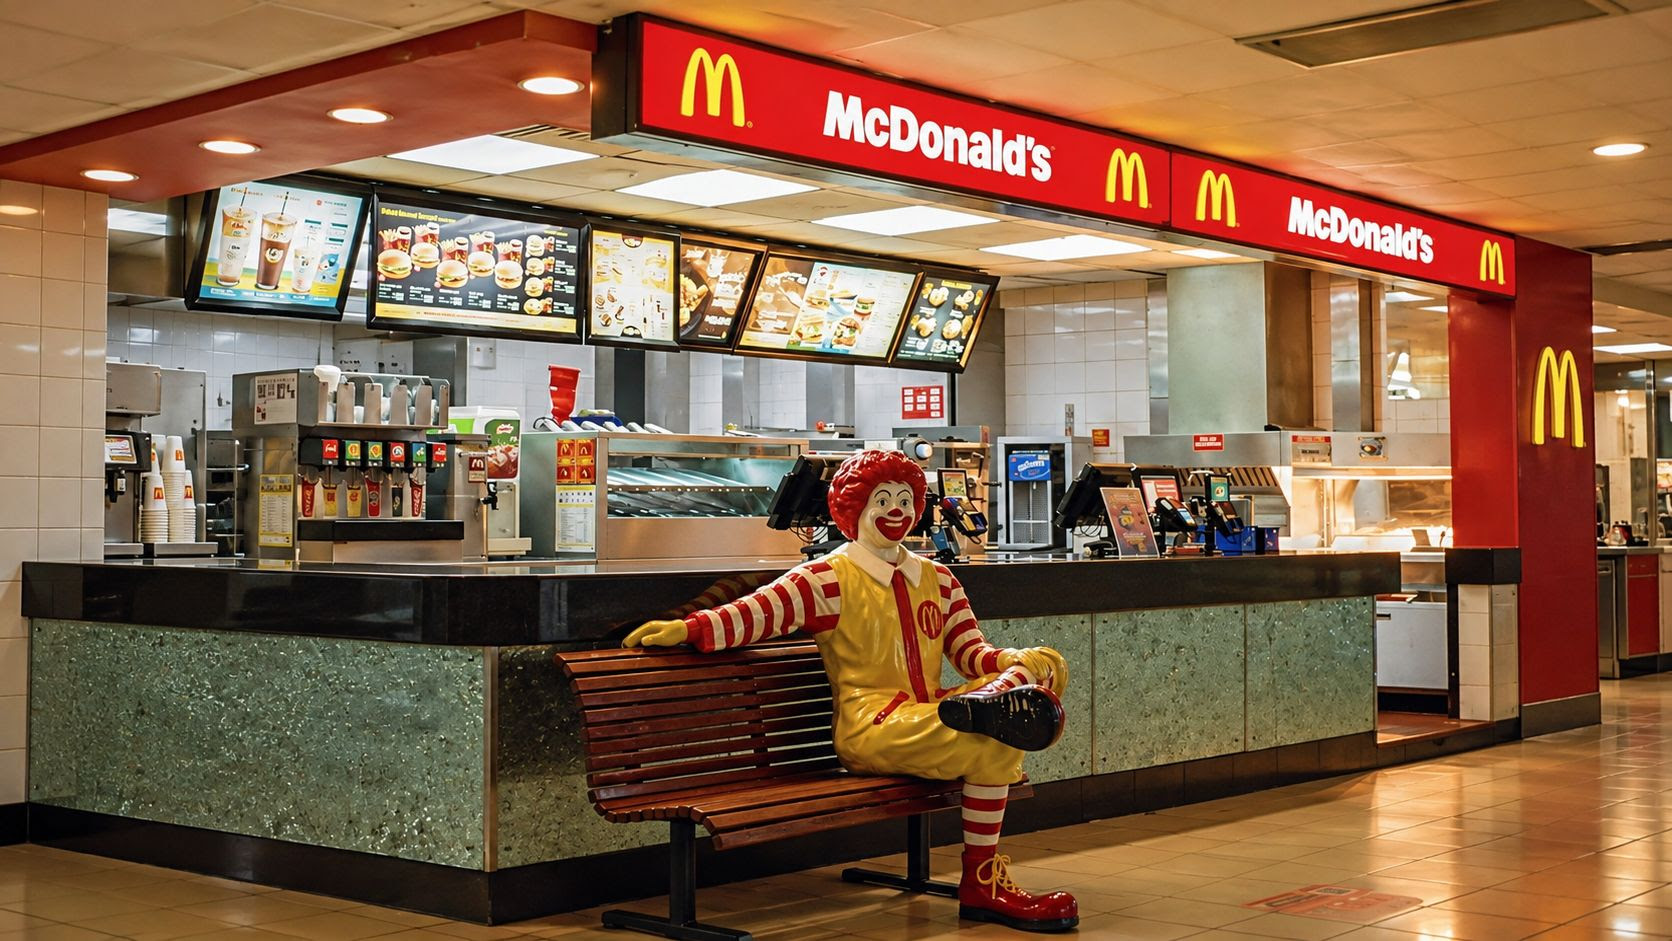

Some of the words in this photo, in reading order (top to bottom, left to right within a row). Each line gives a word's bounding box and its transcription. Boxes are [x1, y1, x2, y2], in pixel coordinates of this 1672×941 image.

[680, 47, 745, 127] M
[823, 91, 1052, 183] McDonald's
[1287, 196, 1434, 264] McDonald's
[1532, 346, 1585, 448] M
